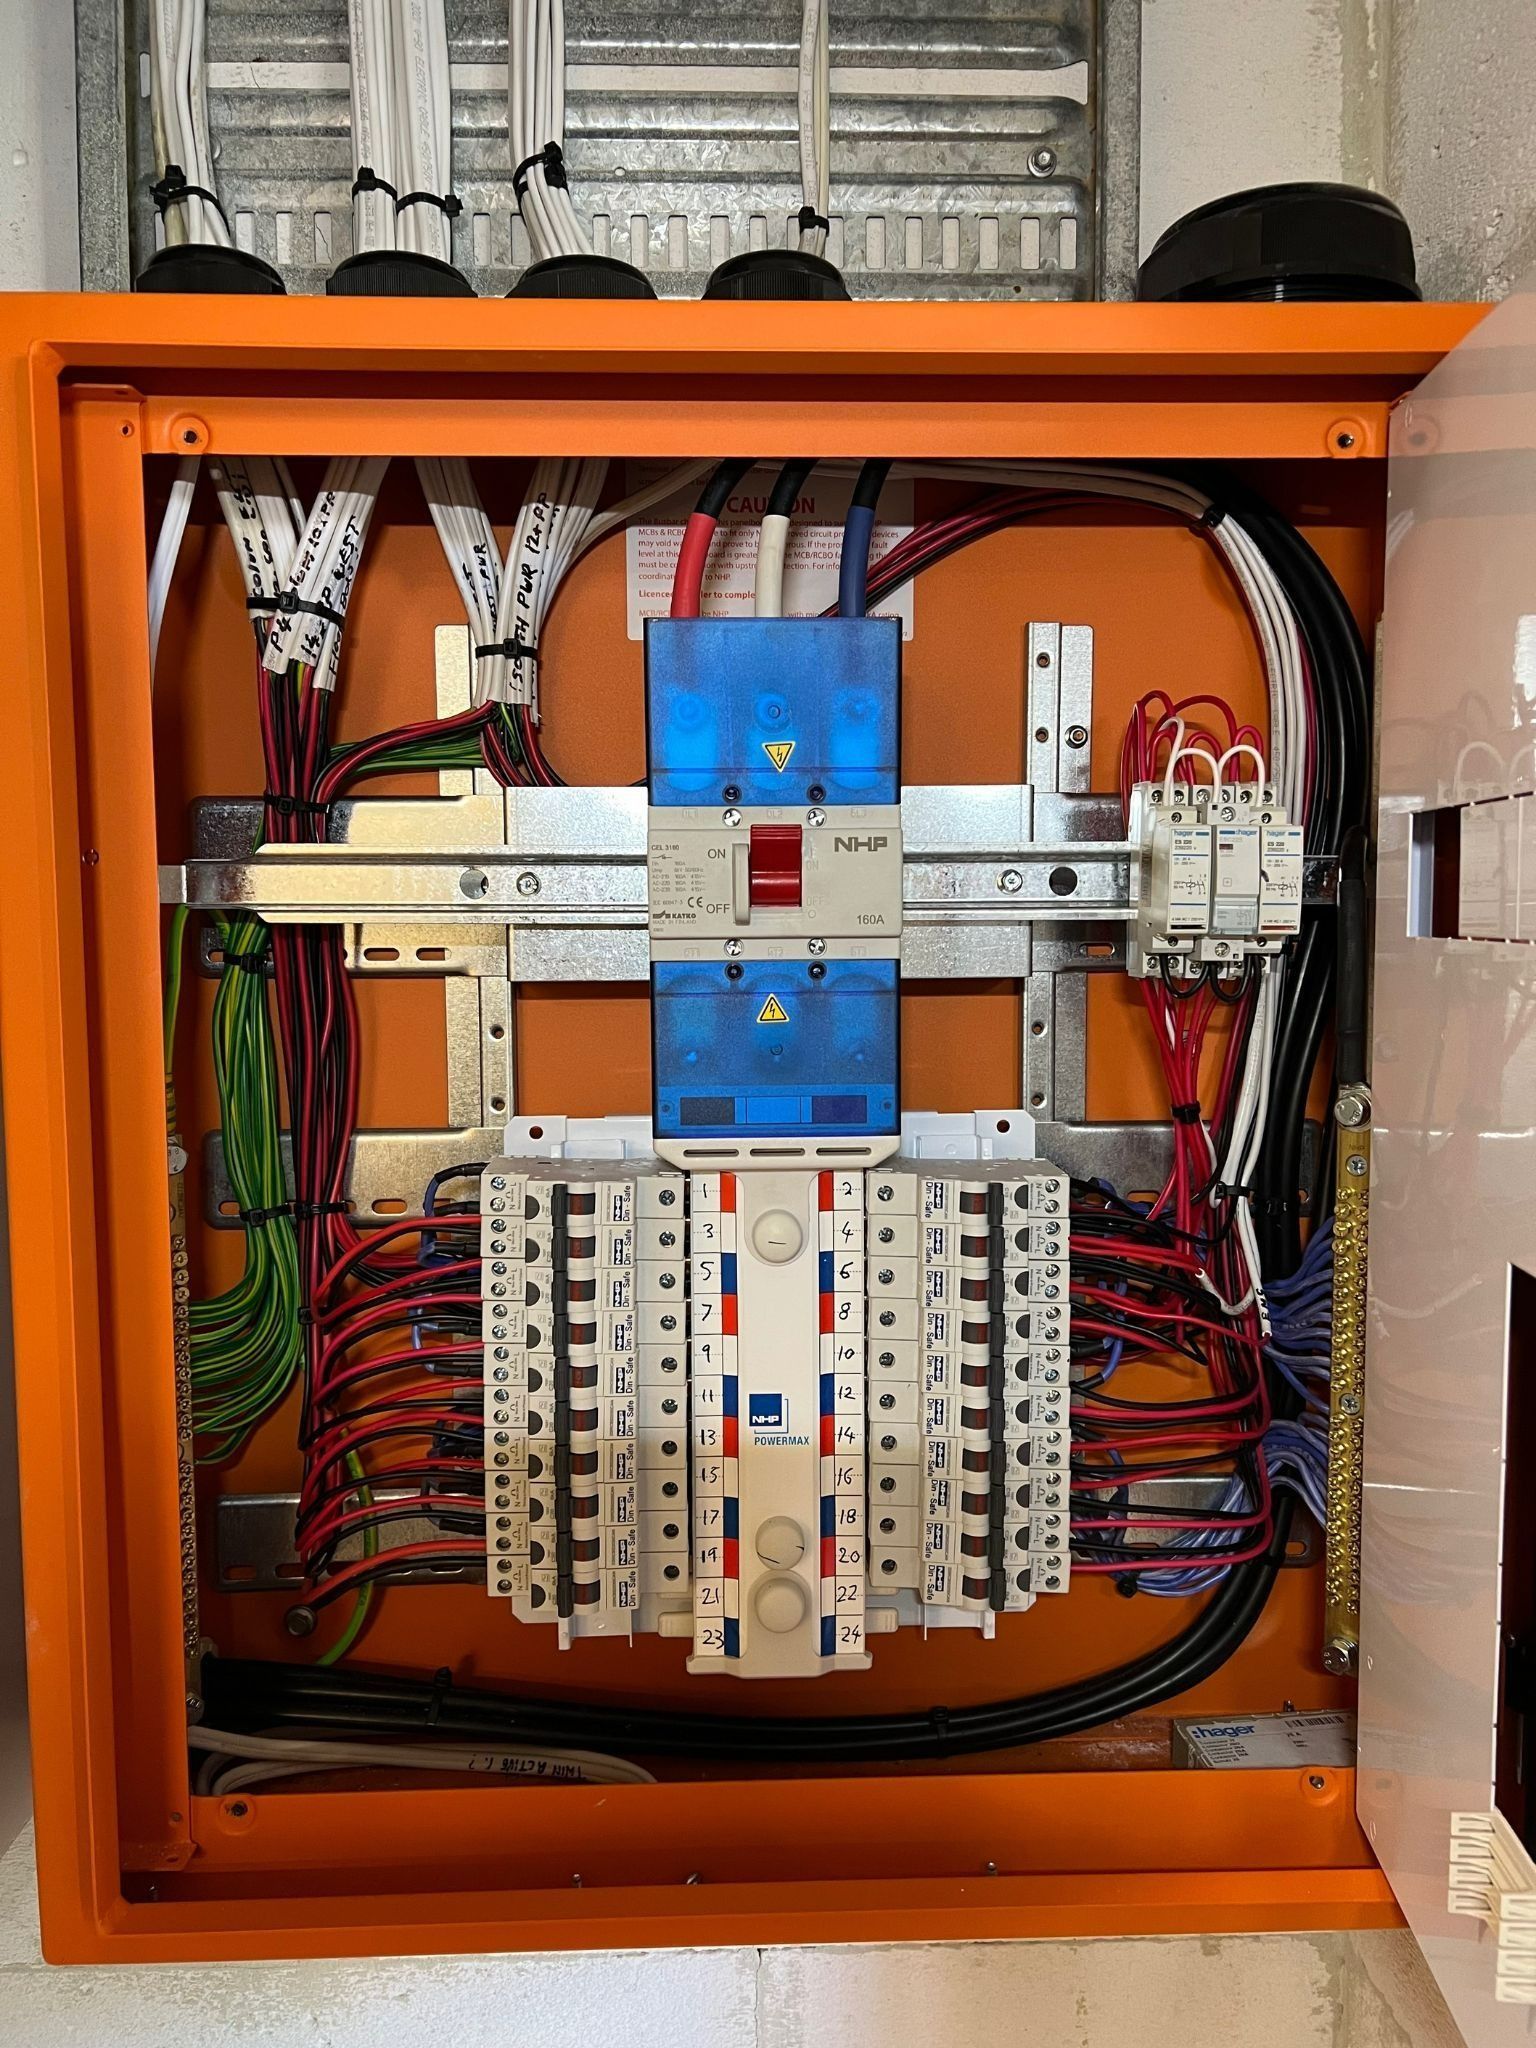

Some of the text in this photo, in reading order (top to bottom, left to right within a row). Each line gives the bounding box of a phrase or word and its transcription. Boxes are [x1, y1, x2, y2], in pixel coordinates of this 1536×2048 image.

[803, 123, 814, 170] ELECTRIC
[726, 497, 815, 515] CAUON
[638, 528, 660, 536] MCBs
[739, 529, 754, 538] only
[638, 541, 653, 550] may
[871, 541, 888, 549] fault
[720, 561, 734, 569] with
[517, 563, 539, 610] PWR
[510, 615, 530, 686] SOTH
[707, 848, 726, 859] ON
[834, 837, 888, 852] NHP
[706, 904, 730, 914] OFF
[856, 914, 885, 925] 160A
[702, 1183, 708, 1199] 1
[842, 1182, 852, 1196] 2
[934, 1183, 943, 1208] NHP
[615, 1195, 623, 1222] NHP
[623, 1185, 631, 1222] Din Safe
[703, 1223, 714, 1239] 3
[842, 1221, 853, 1243] 4
[934, 1228, 943, 1254] NHP
[615, 1239, 623, 1265] NHP
[624, 1229, 632, 1265] Din Safe
[700, 1261, 715, 1281] 5
[839, 1262, 854, 1279] 6
[614, 1281, 622, 1307] NHP
[623, 1271, 631, 1307] Din Safe
[934, 1271, 943, 1297] NHP
[701, 1303, 713, 1321] 7
[838, 1302, 852, 1320] 8
[625, 1314, 633, 1351] Din Safe
[935, 1313, 944, 1339] NHP
[616, 1325, 624, 1351] NHP
[702, 1344, 711, 1363] 9
[838, 1345, 856, 1361] 10
[626, 1357, 634, 1394] Din Safe
[934, 1356, 943, 1382] NHP
[616, 1367, 625, 1393] NHP
[702, 1388, 714, 1403] 11
[838, 1386, 856, 1400] 12
[626, 1400, 634, 1437] Din Safe
[752, 1415, 780, 1424] NHP
[934, 1399, 943, 1425] NHP
[618, 1411, 626, 1436] NHP
[700, 1428, 717, 1446] 13
[754, 1436, 811, 1446] POWERMAX
[837, 1426, 856, 1444] 14
[626, 1443, 634, 1480] Din Safe
[927, 1442, 936, 1477] Din Safe
[936, 1442, 945, 1468] NHP
[617, 1454, 625, 1479] NHP
[701, 1466, 721, 1484] 15
[837, 1467, 853, 1487] 16
[627, 1486, 635, 1522] Din Safe
[938, 1481, 946, 1506] NHP
[618, 1497, 626, 1522] NHP
[702, 1509, 720, 1525] 17
[839, 1508, 858, 1525] 18
[929, 1498, 937, 1515] Safe
[926, 1522, 934, 1536] Din
[934, 1523, 943, 1549] NHP
[619, 1540, 627, 1565] NHP
[628, 1529, 636, 1565] Din Safe
[701, 1549, 718, 1564] 19
[838, 1547, 861, 1564] 20
[628, 1570, 636, 1607] Din Safe
[935, 1566, 944, 1591] NHP
[619, 1581, 628, 1606] NHP
[702, 1587, 720, 1605] 21
[836, 1585, 858, 1603] 22
[702, 1629, 725, 1649] 23
[840, 1624, 863, 1644] 24
